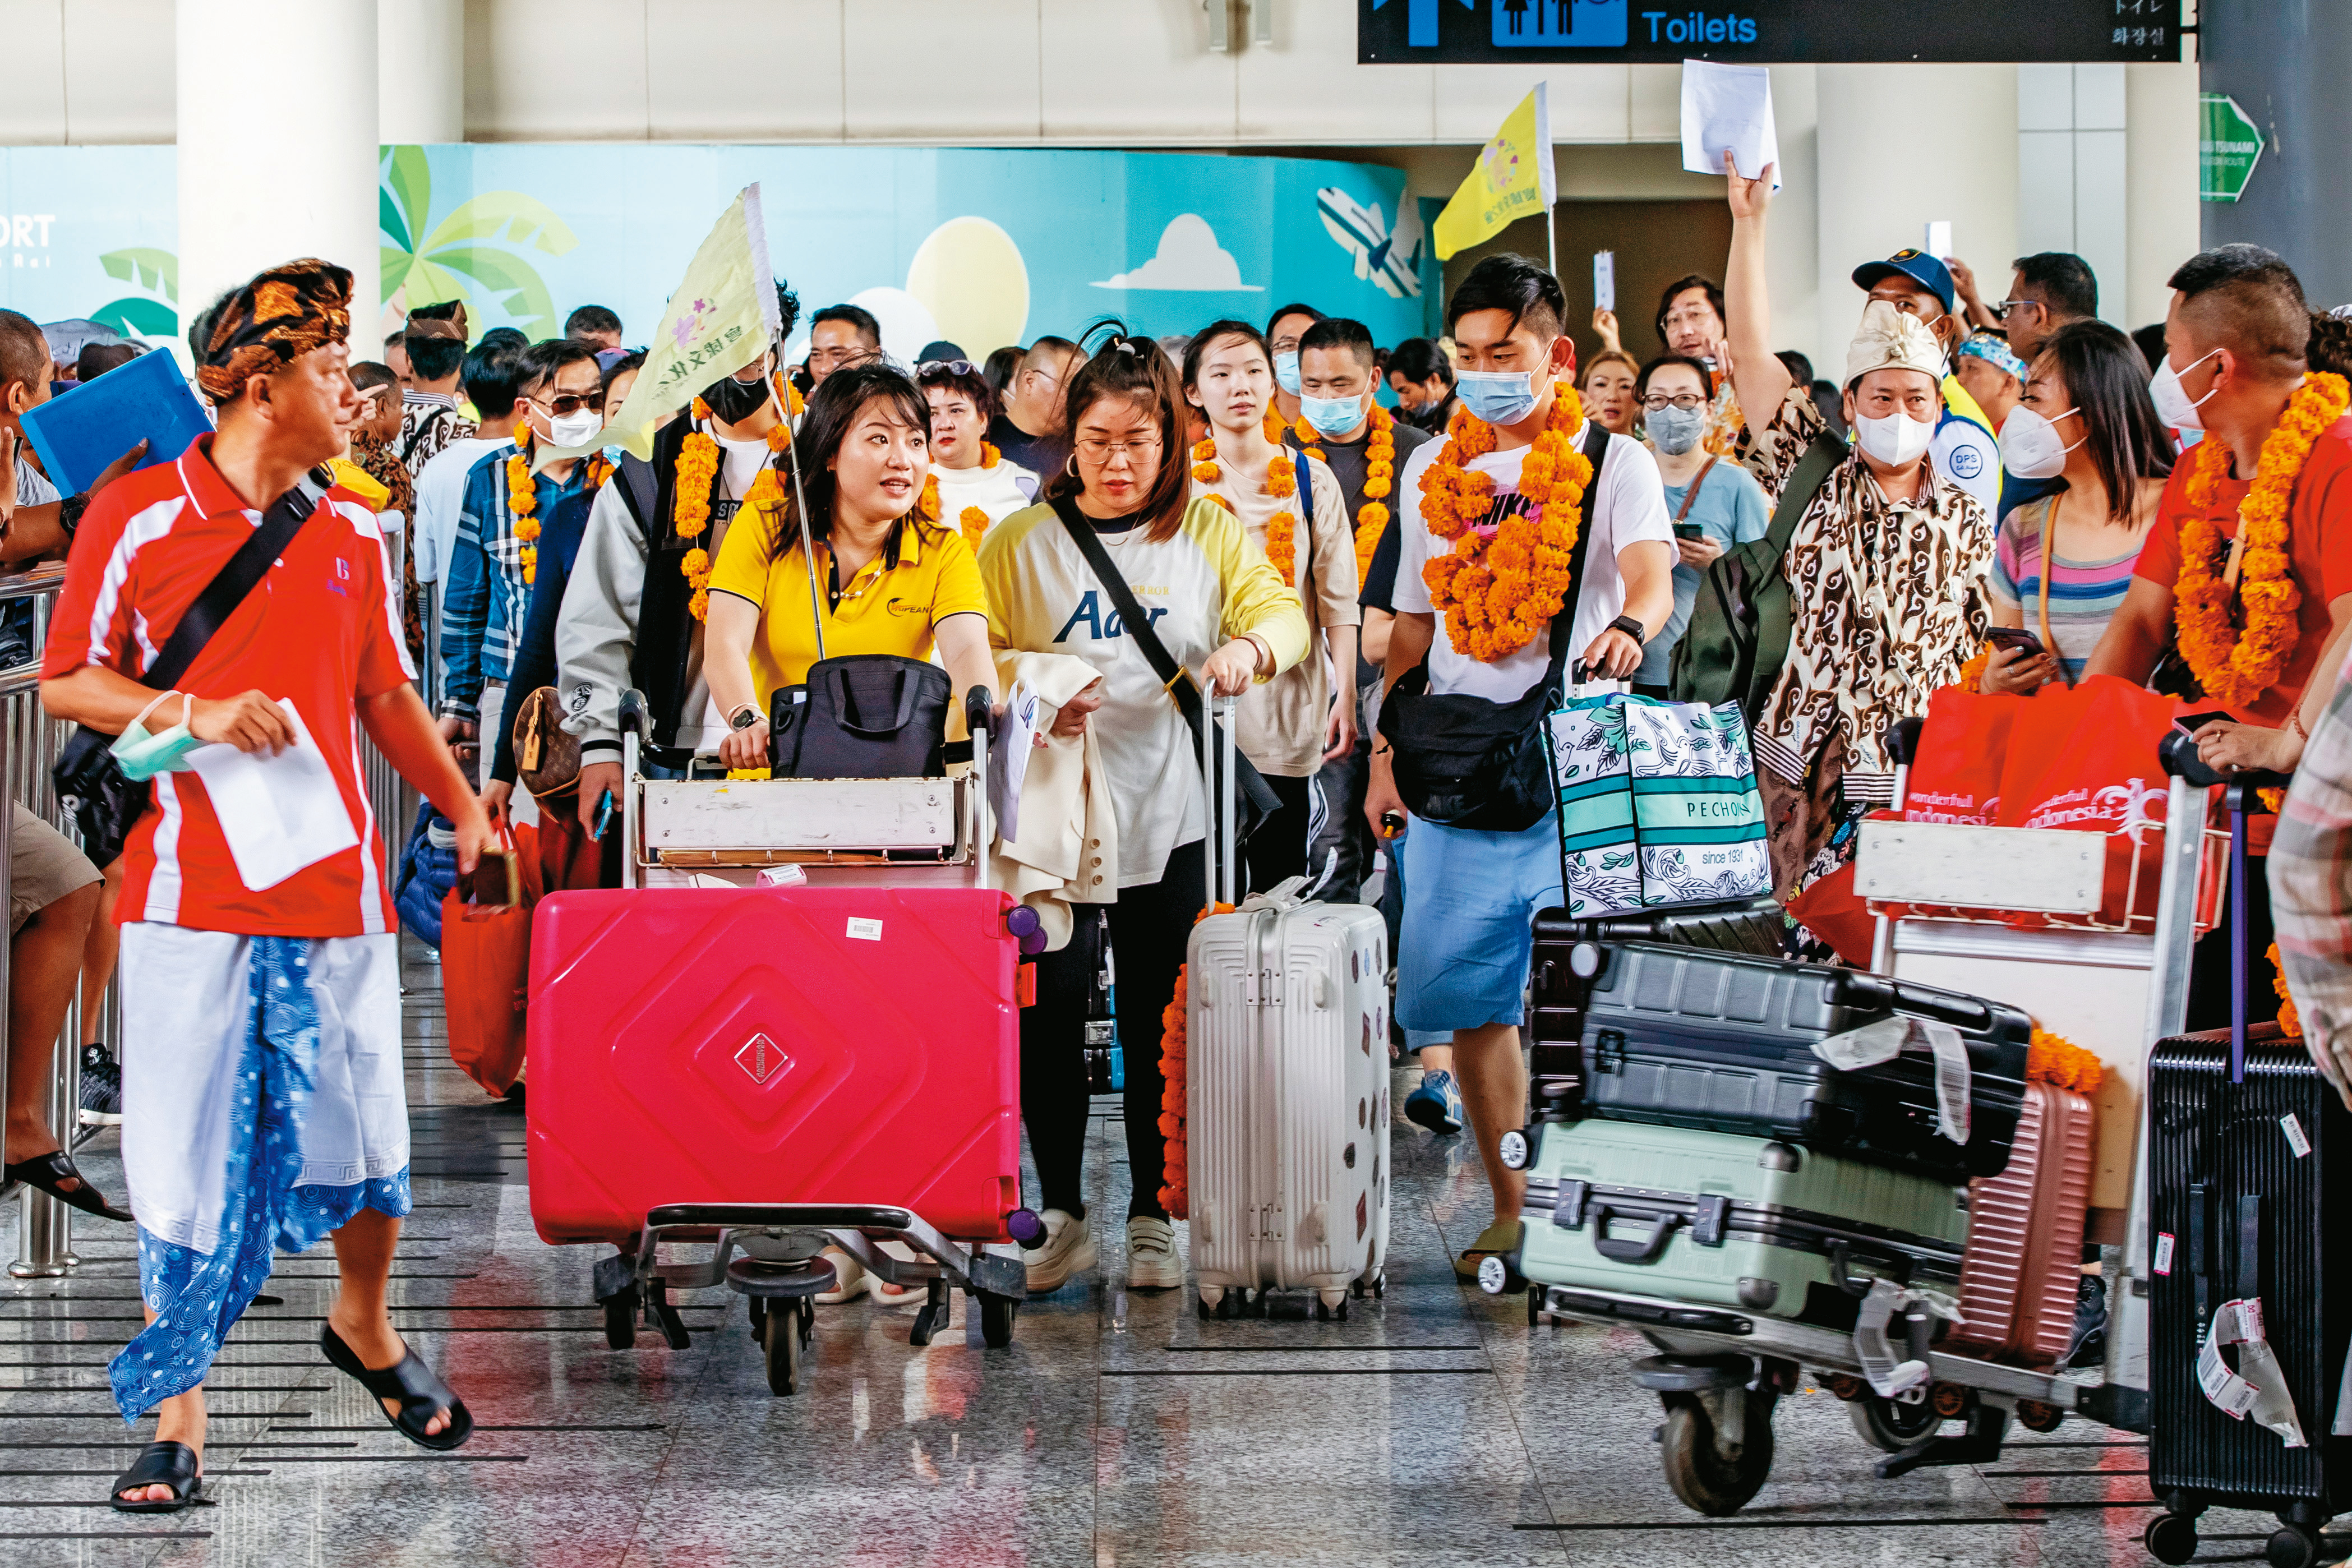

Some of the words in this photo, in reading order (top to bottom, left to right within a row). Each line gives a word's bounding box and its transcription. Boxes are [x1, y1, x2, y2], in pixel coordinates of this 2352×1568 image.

[1641, 11, 1757, 43] Toilets
[2112, 27, 2165, 46] 화장실
[1956, 454, 1977, 464] DPS
[1132, 585, 1170, 596] ERROR
[1052, 590, 1168, 643] Adr
[1702, 851, 1726, 864] since
[1728, 848, 1744, 863] 1931
